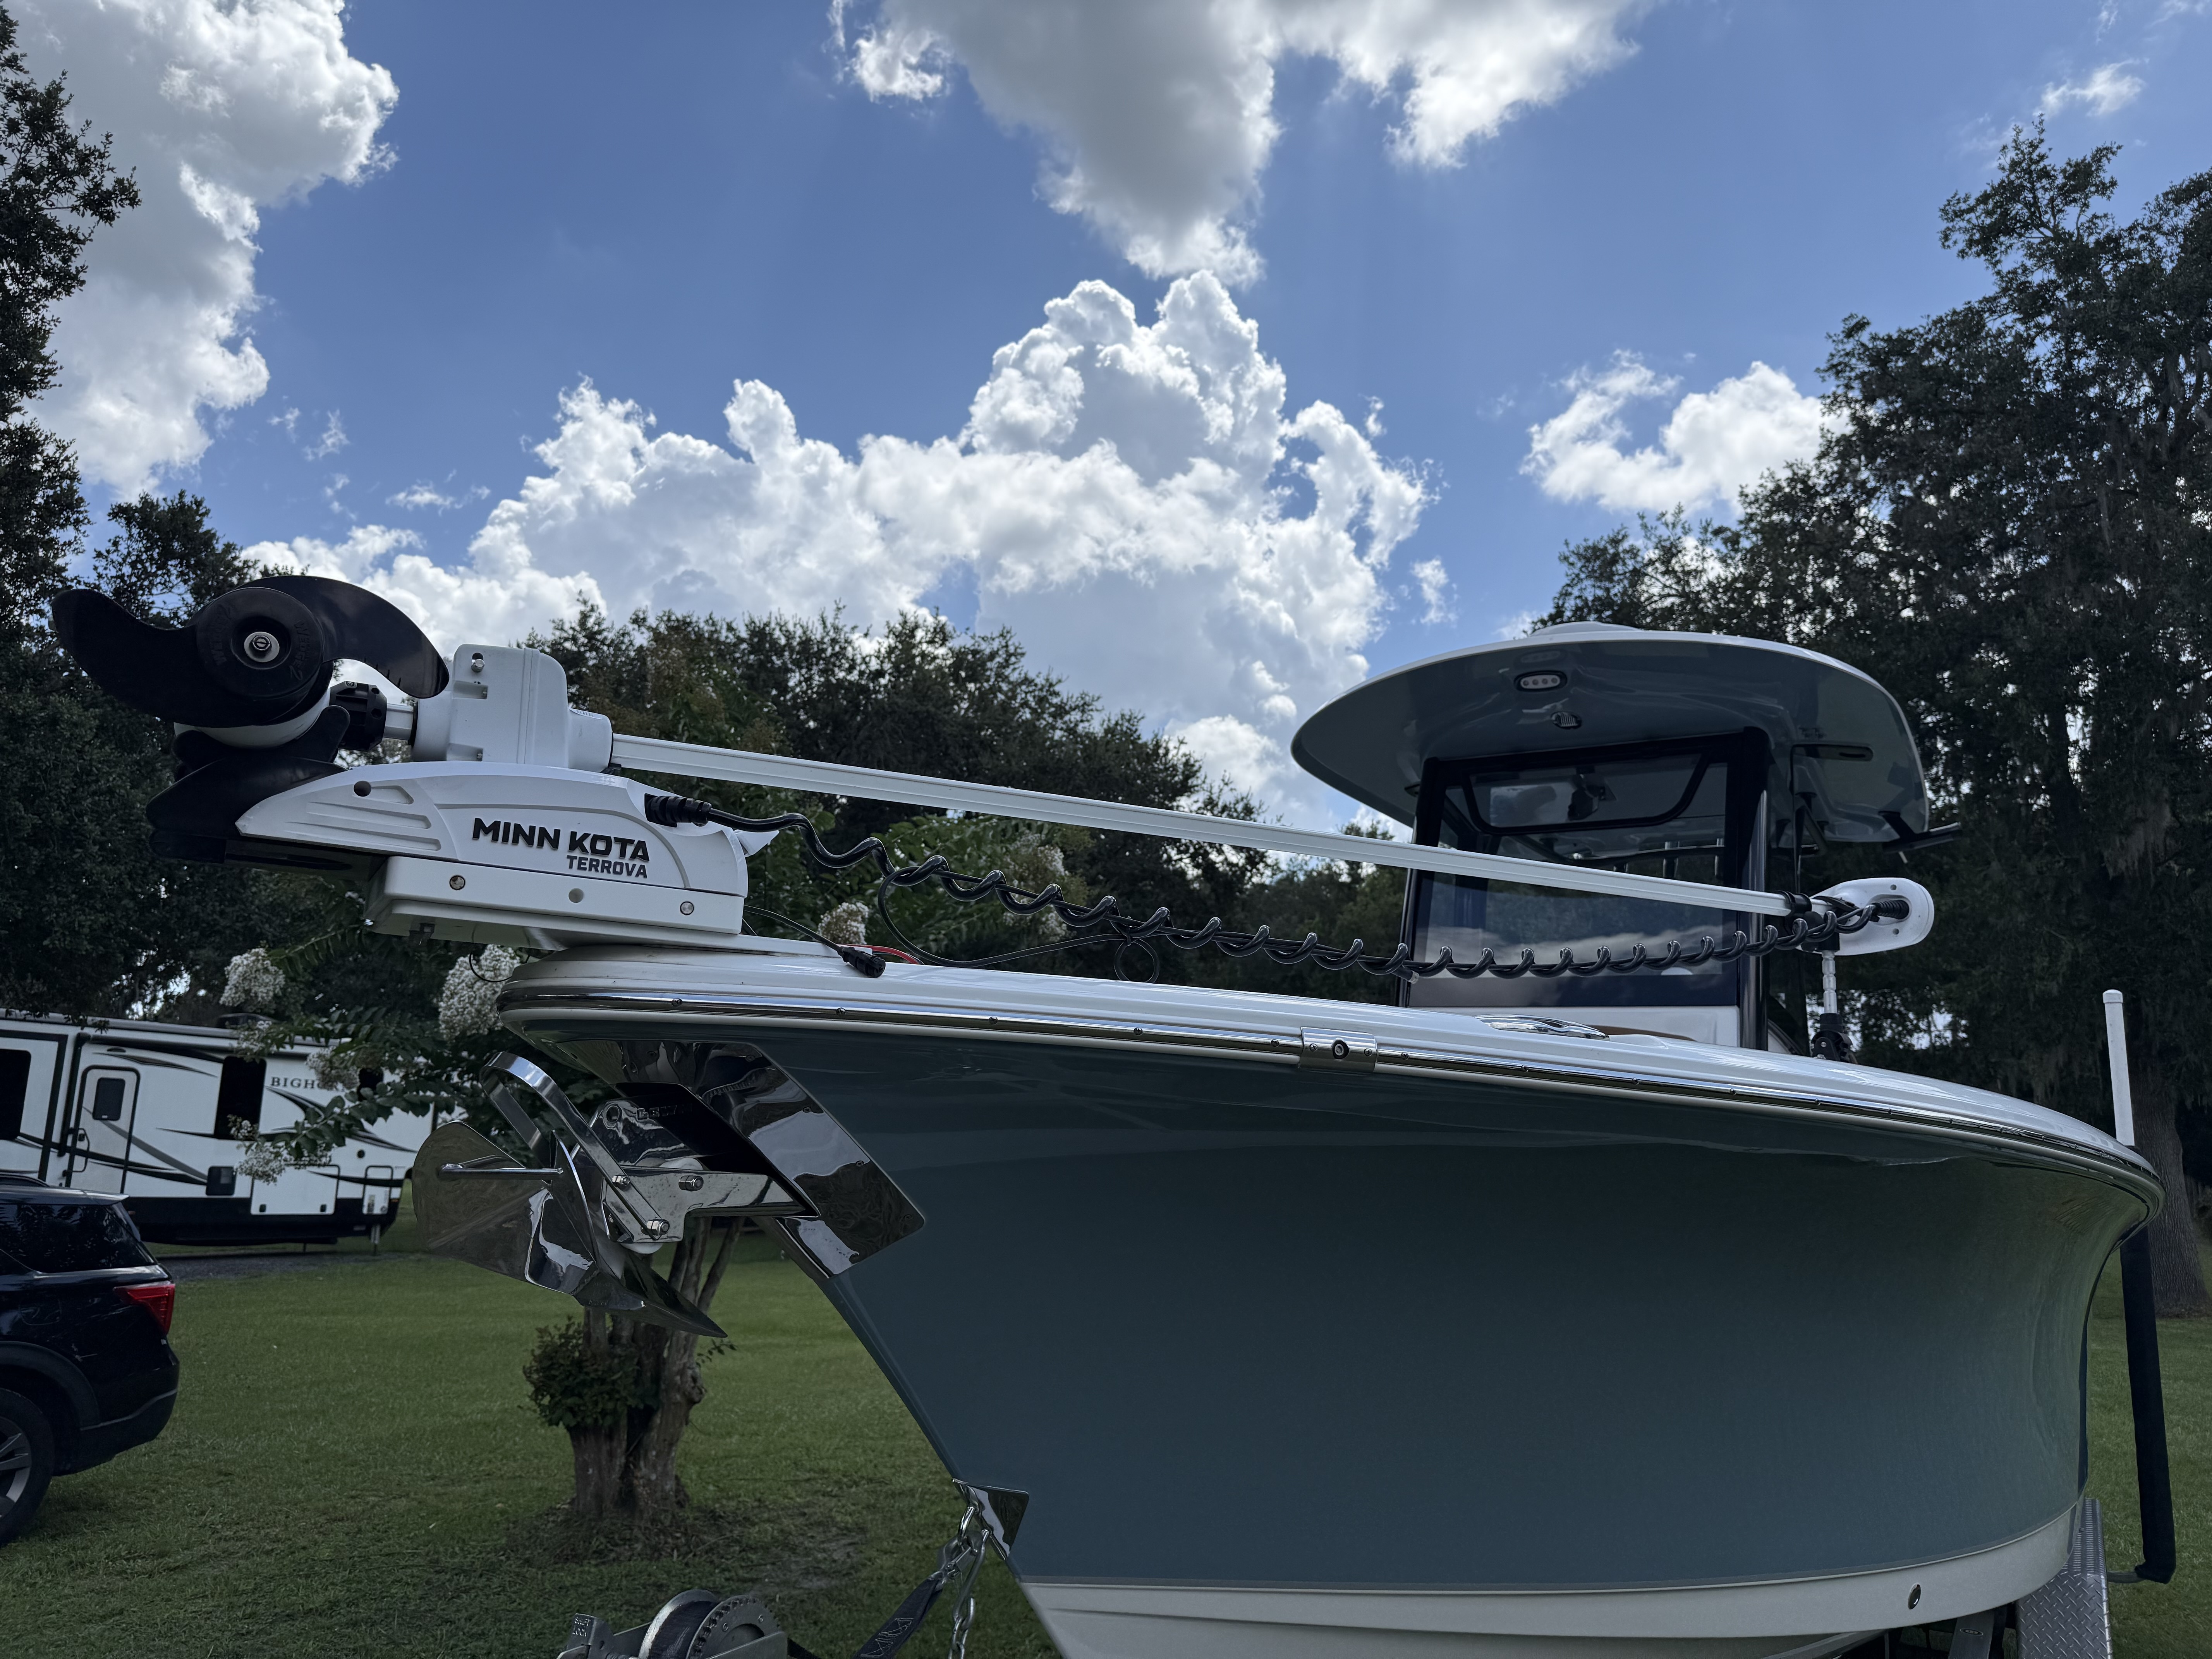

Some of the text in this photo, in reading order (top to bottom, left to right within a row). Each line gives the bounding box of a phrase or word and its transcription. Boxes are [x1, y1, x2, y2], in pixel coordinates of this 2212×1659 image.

[472, 817, 650, 862] MINN KOTA
[567, 855, 647, 878] TERROVA
[271, 1076, 345, 1092] BIGH
